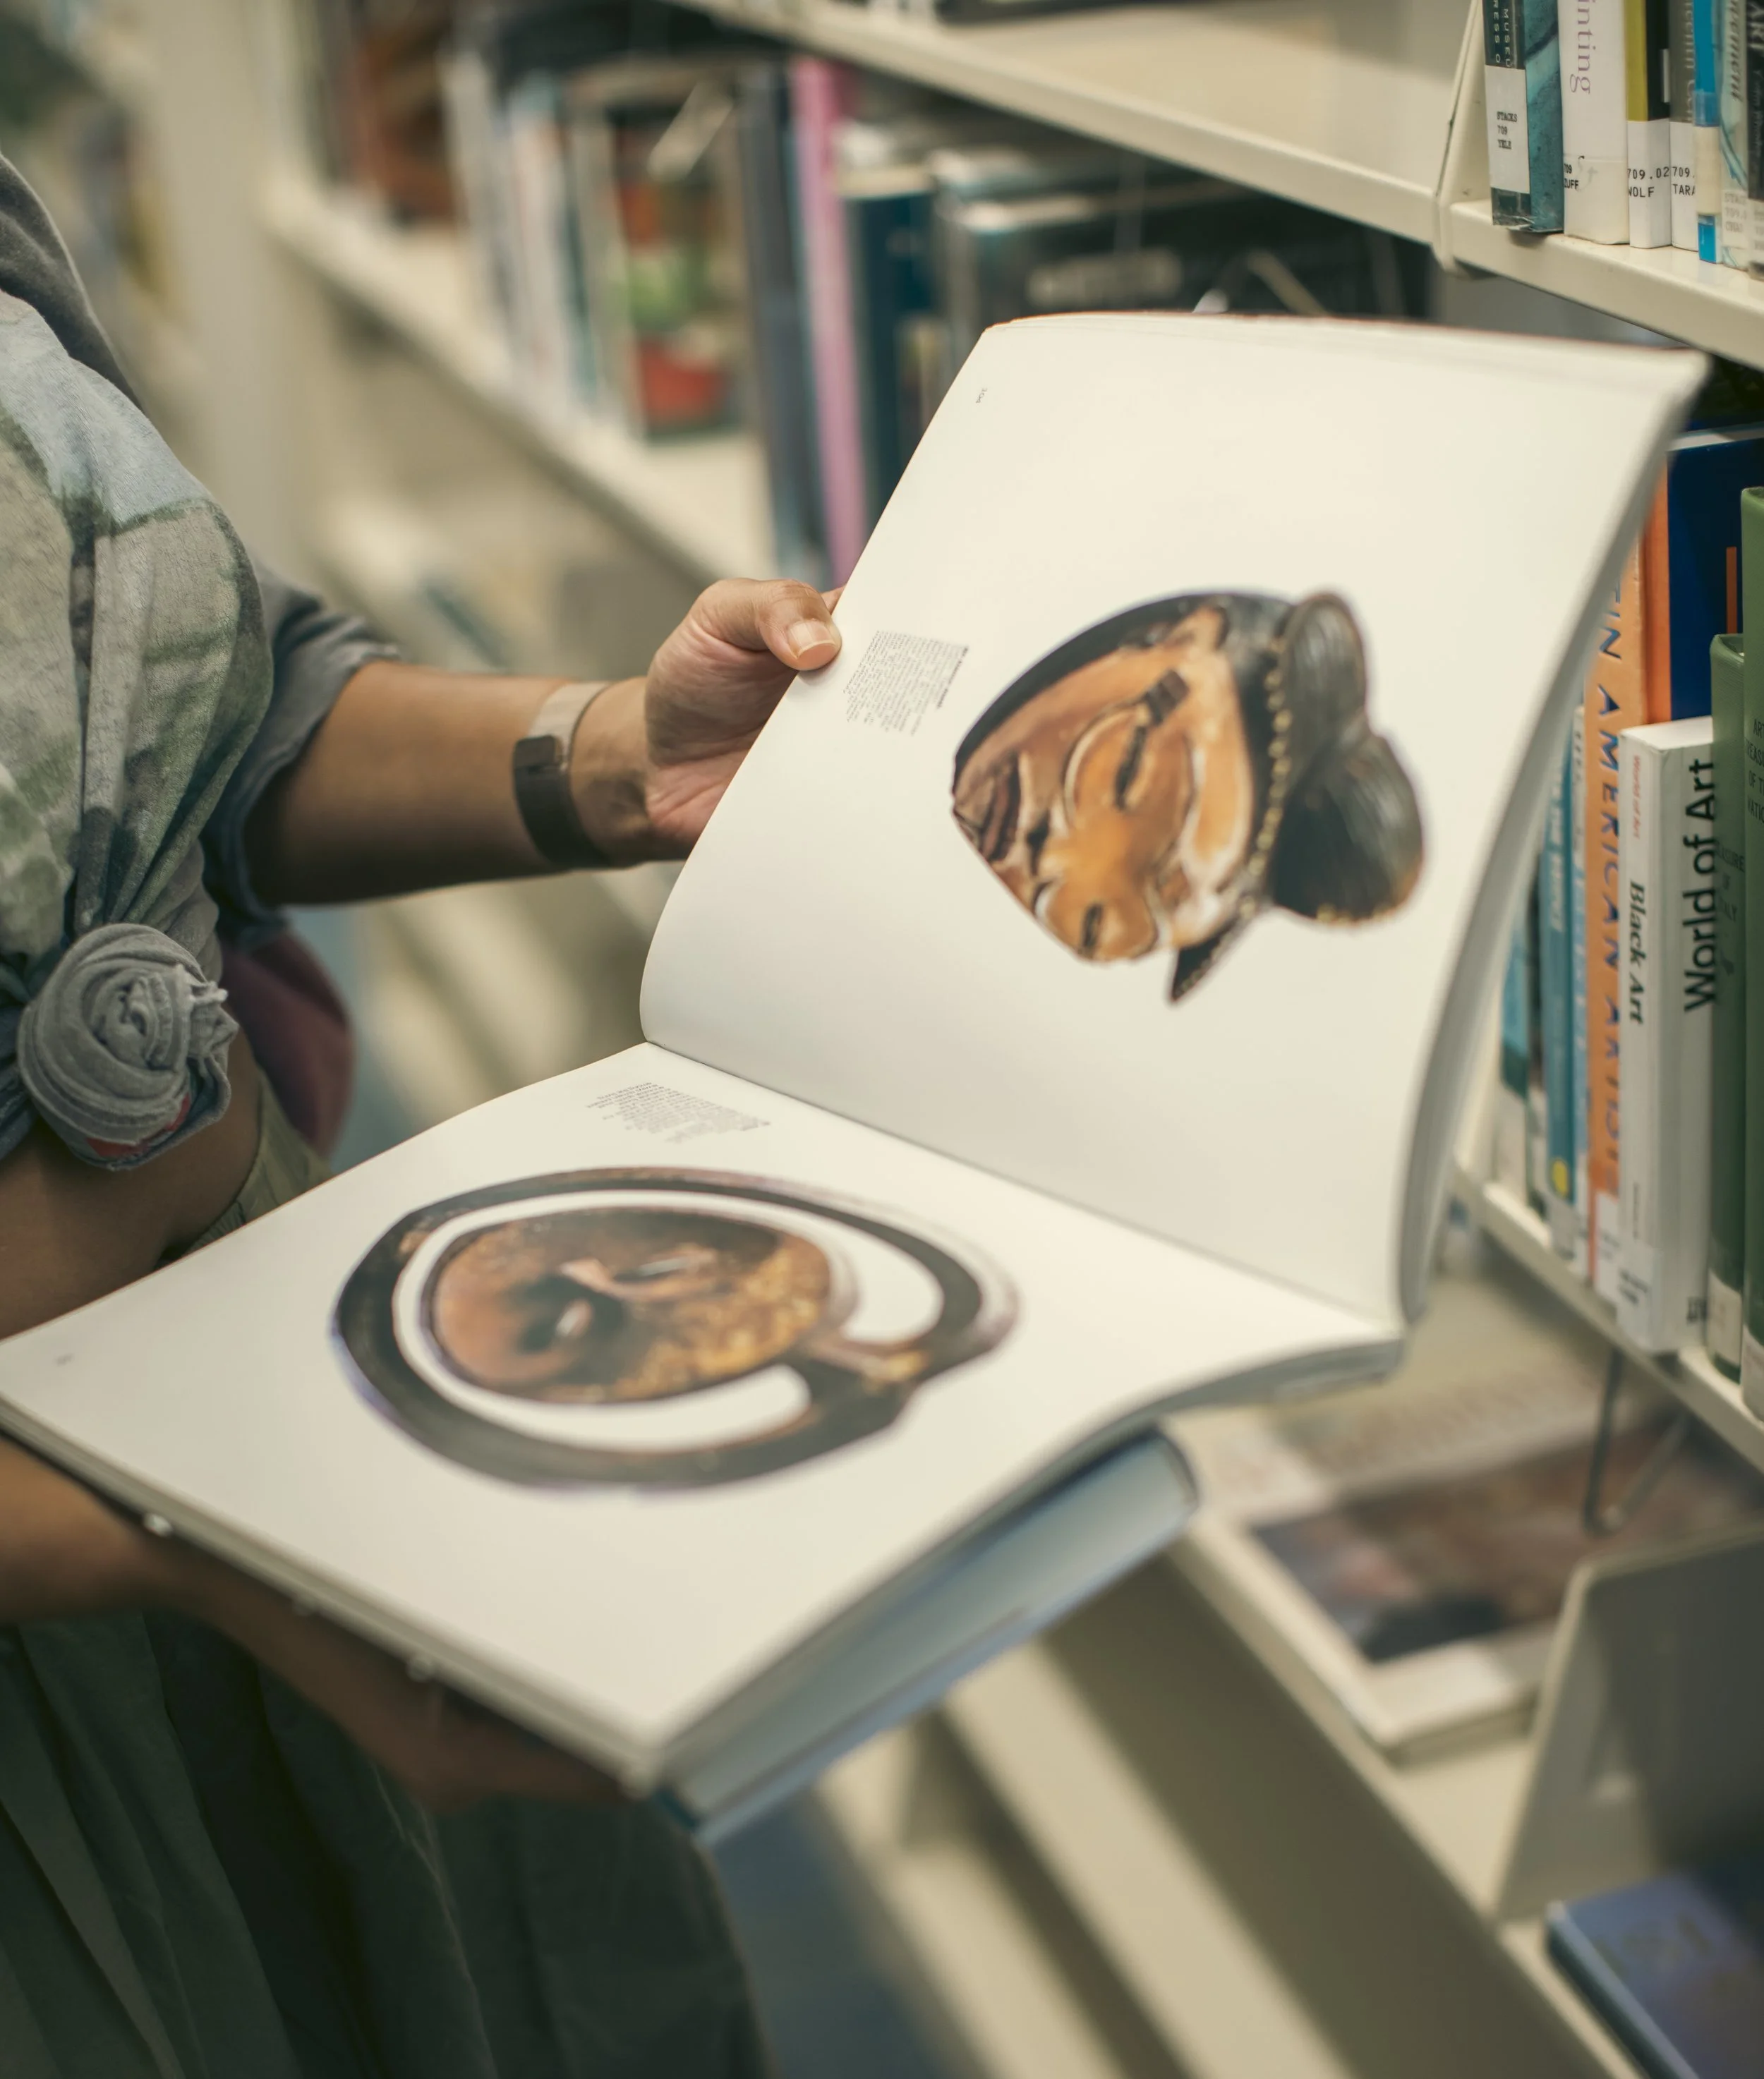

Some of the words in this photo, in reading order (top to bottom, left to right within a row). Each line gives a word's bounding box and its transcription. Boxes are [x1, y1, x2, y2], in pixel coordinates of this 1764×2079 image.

[1497, 111, 1518, 122] STACKS
[1497, 125, 1507, 135] 709
[1628, 166, 1669, 180] 709.02
[1685, 758, 1715, 821] Art
[1597, 684, 1621, 968] AMERICAN
[1683, 834, 1715, 875] of
[1629, 879, 1646, 967] Black
[1683, 887, 1716, 1013] World
[1629, 973, 1645, 1024] Art
